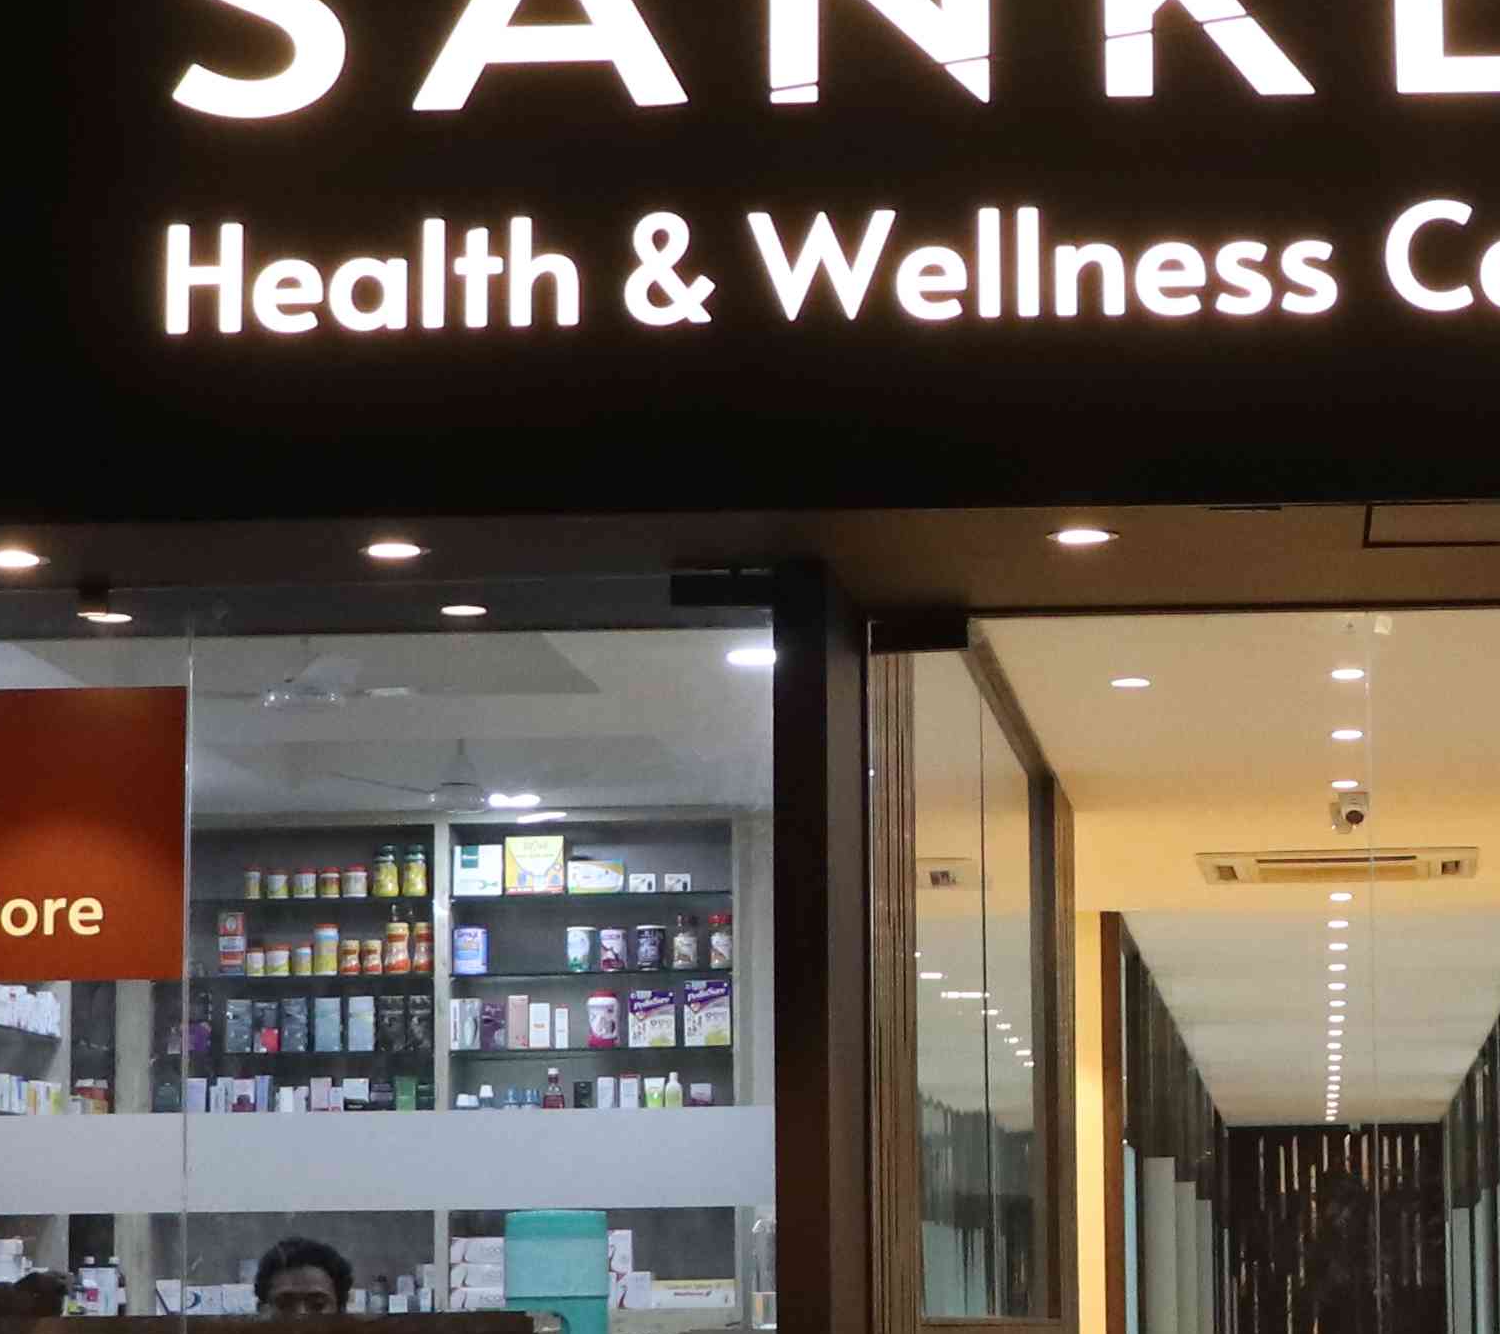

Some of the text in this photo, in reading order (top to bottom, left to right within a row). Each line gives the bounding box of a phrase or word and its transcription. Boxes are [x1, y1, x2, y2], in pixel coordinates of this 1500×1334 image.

[164, 215, 581, 336] Health
[622, 211, 717, 327] &
[746, 205, 1340, 323] Wellness
